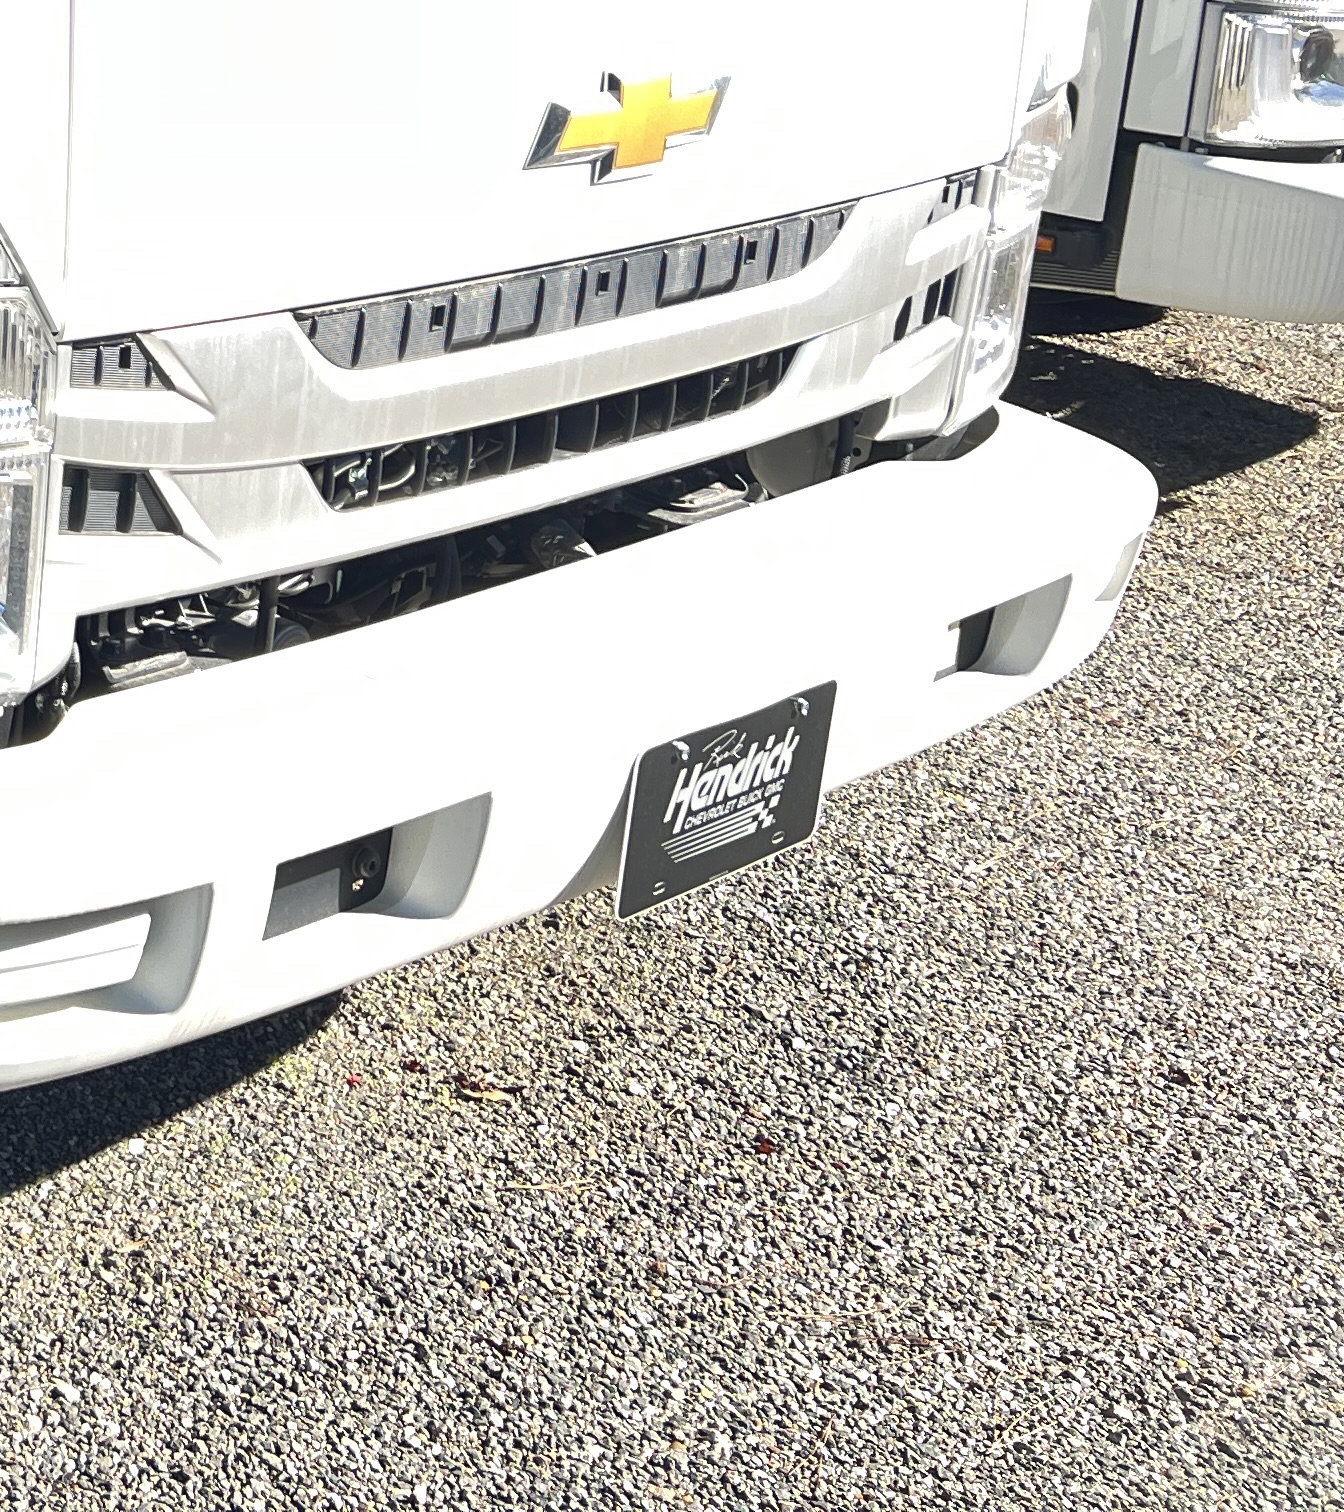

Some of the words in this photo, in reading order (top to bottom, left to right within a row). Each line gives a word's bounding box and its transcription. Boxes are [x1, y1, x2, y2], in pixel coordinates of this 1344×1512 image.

[663, 726, 800, 835] Hendrick
[684, 799, 738, 830] CHEVROLET
[737, 787, 765, 809] BUICK
[764, 778, 786, 797] GMC
